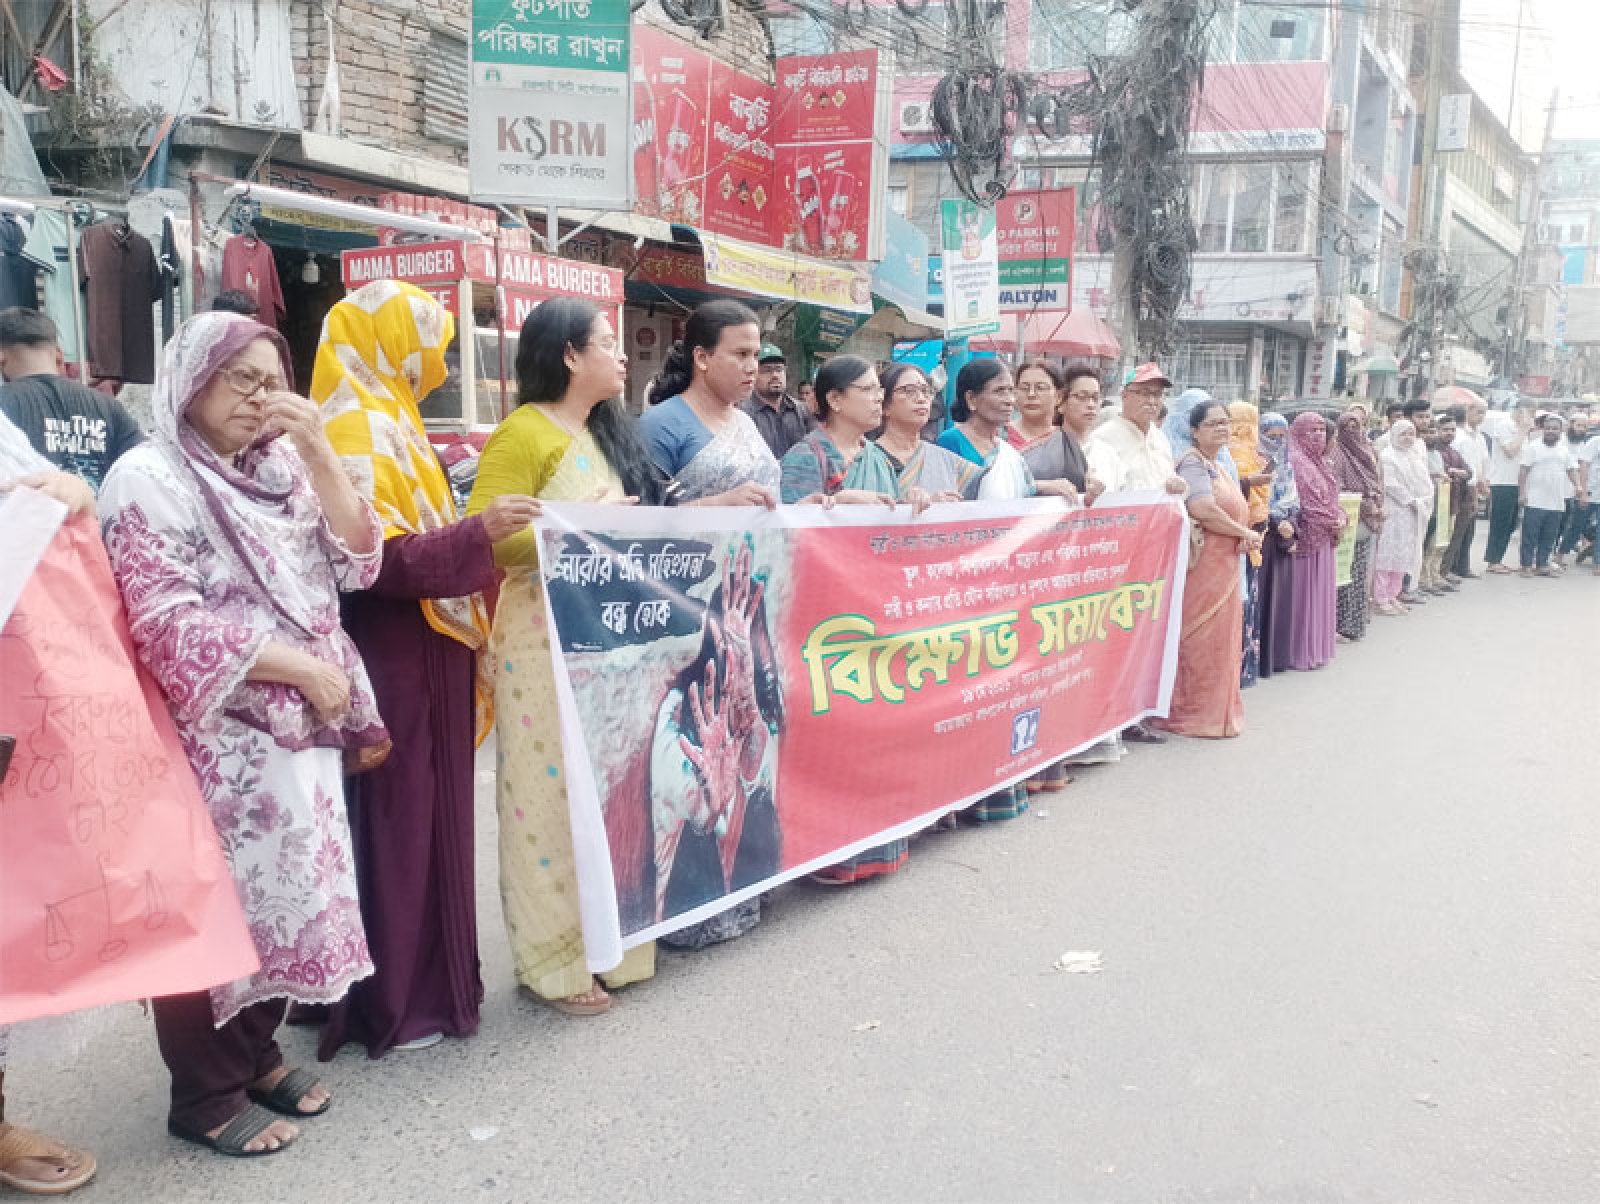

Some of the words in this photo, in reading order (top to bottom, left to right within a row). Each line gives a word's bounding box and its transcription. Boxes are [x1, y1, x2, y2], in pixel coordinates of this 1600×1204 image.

[478, 24, 560, 56] পরিষ্কার
[567, 35, 624, 64] রাখুন
[498, 115, 606, 160] KSRM
[350, 255, 393, 281] MAMA
[397, 250, 455, 276] BURGER
[549, 266, 611, 297] BURGER
[560, 543, 612, 586] নারীর
[617, 543, 645, 582] প্রতি
[601, 602, 631, 634] বন্ধ
[634, 600, 671, 634] হোক
[802, 611, 1018, 716] বিক্ষোভ
[1031, 578, 1166, 657] সমাবেশ
